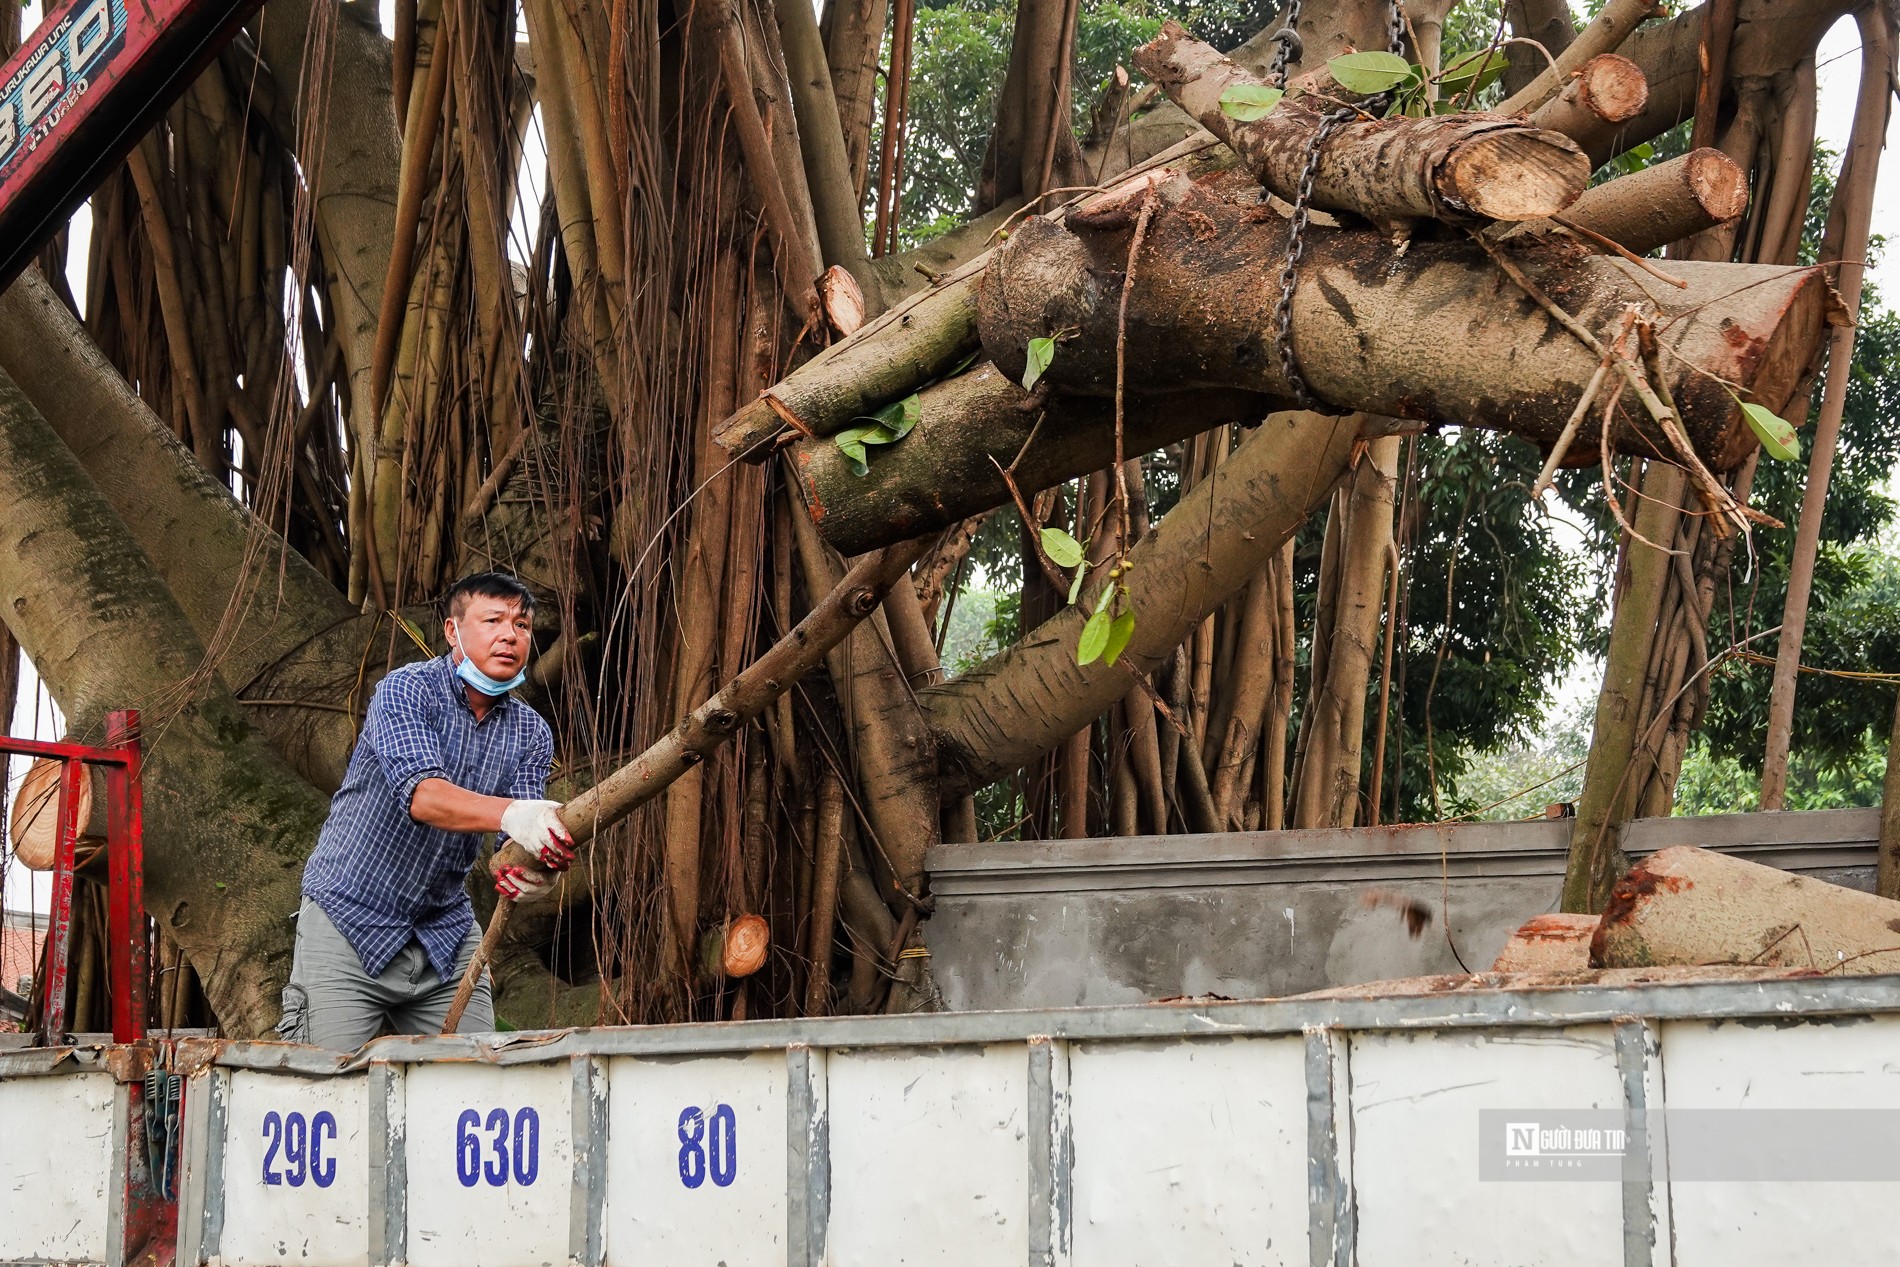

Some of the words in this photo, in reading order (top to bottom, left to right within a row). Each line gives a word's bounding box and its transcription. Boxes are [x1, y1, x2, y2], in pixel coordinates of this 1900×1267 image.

[0, 43, 49, 101] URUKAWA
[50, 15, 73, 46] UNIC
[264, 1112, 336, 1187] 29C
[457, 1108, 538, 1186] 630
[679, 1105, 736, 1188] 80
